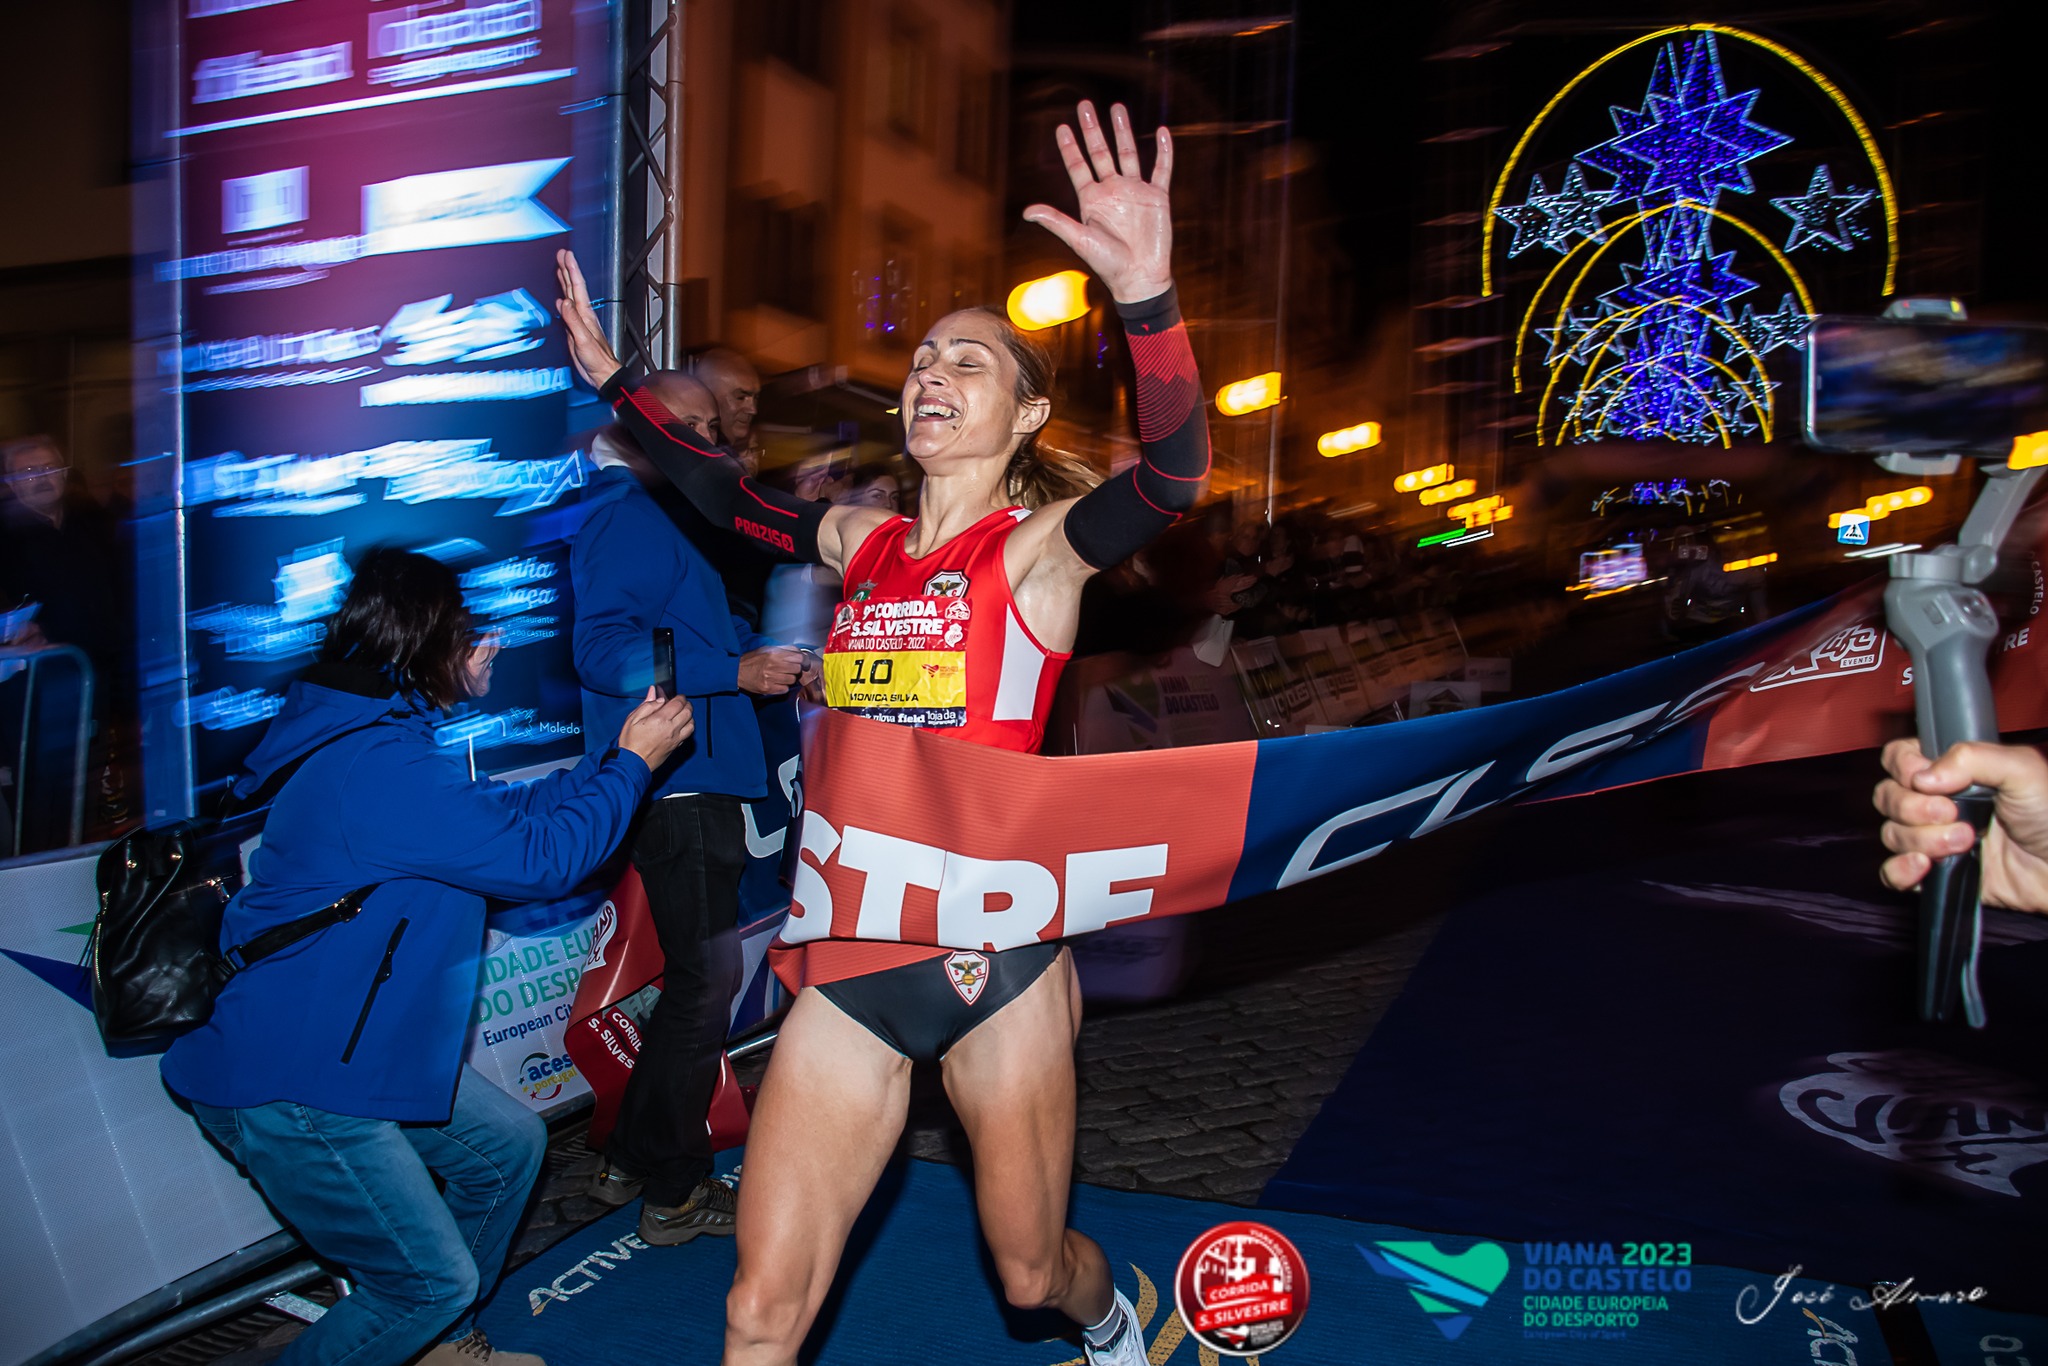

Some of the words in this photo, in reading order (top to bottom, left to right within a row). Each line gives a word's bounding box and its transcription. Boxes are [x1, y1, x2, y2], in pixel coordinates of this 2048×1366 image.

[875, 600, 938, 619] CORRIDA
[907, 638, 925, 650] 2022
[1843, 656, 1873, 666] EVENTS
[850, 658, 893, 685] 10
[1159, 676, 1191, 693] VIANA
[850, 693, 887, 702] MONICA
[890, 693, 919, 702] SILVA
[1165, 695, 1180, 714] DO
[1180, 694, 1219, 713] CASTELO
[540, 722, 580, 734] Moledo
[898, 713, 925, 723] field
[481, 940, 559, 986] IDADE
[518, 963, 584, 1008] DESP
[483, 1013, 553, 1047] European
[527, 1054, 573, 1081] aces
[534, 1066, 577, 1093] portugal
[528, 1231, 650, 1315] ACTIVE
